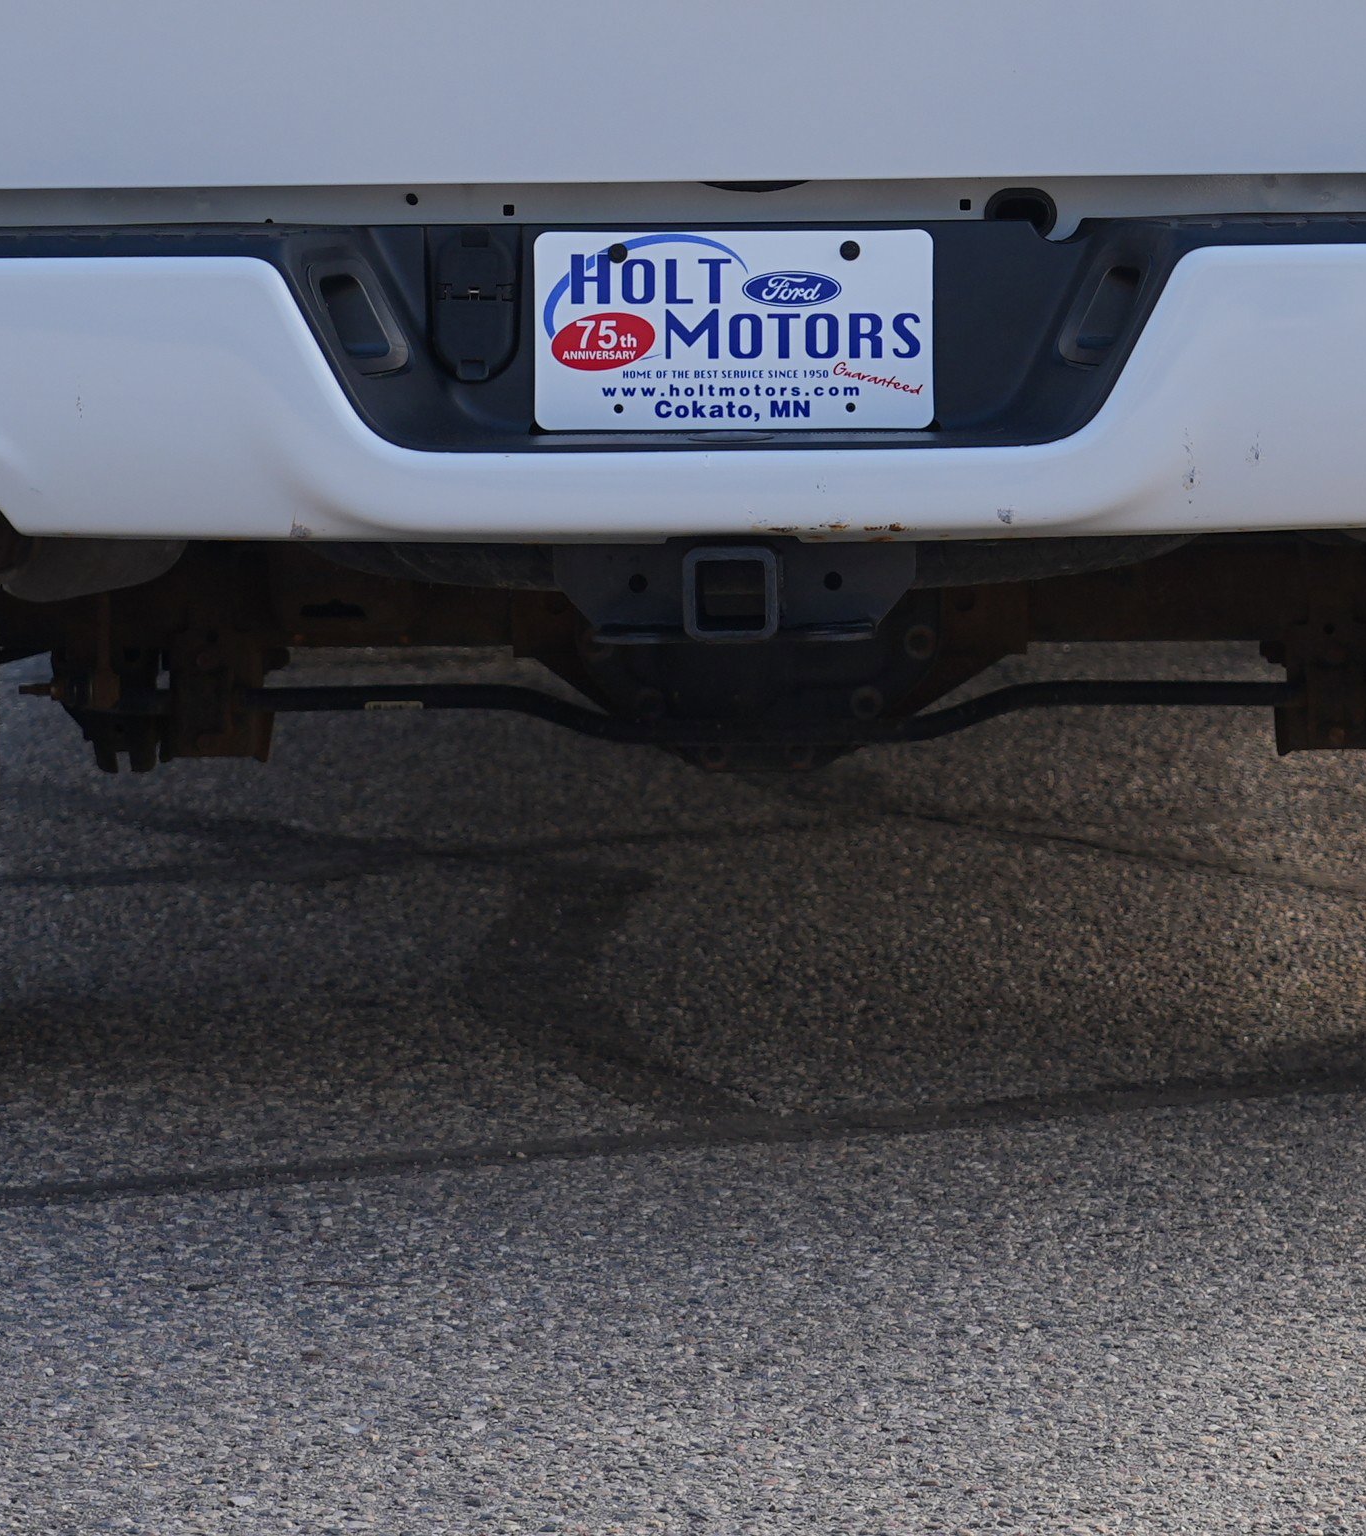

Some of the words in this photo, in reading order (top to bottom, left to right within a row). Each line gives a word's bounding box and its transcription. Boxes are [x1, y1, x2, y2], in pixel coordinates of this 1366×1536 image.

[571, 253, 732, 304] HOLT
[761, 276, 821, 301] Ford
[576, 320, 638, 350] 75th
[665, 309, 921, 360] MOTORS
[562, 350, 636, 361] ANNIVERSARY
[622, 370, 652, 380] HOME
[656, 370, 669, 380] OF
[672, 370, 690, 380] THE
[694, 370, 718, 379] BEST
[721, 369, 764, 379] SERVICE
[768, 369, 799, 379] SINCE
[803, 369, 829, 379] 1950
[833, 361, 924, 396] Guaranteed
[602, 384, 860, 398] www.holtmotors.com
[654, 401, 761, 422] Cokato,
[770, 400, 811, 418] MN
